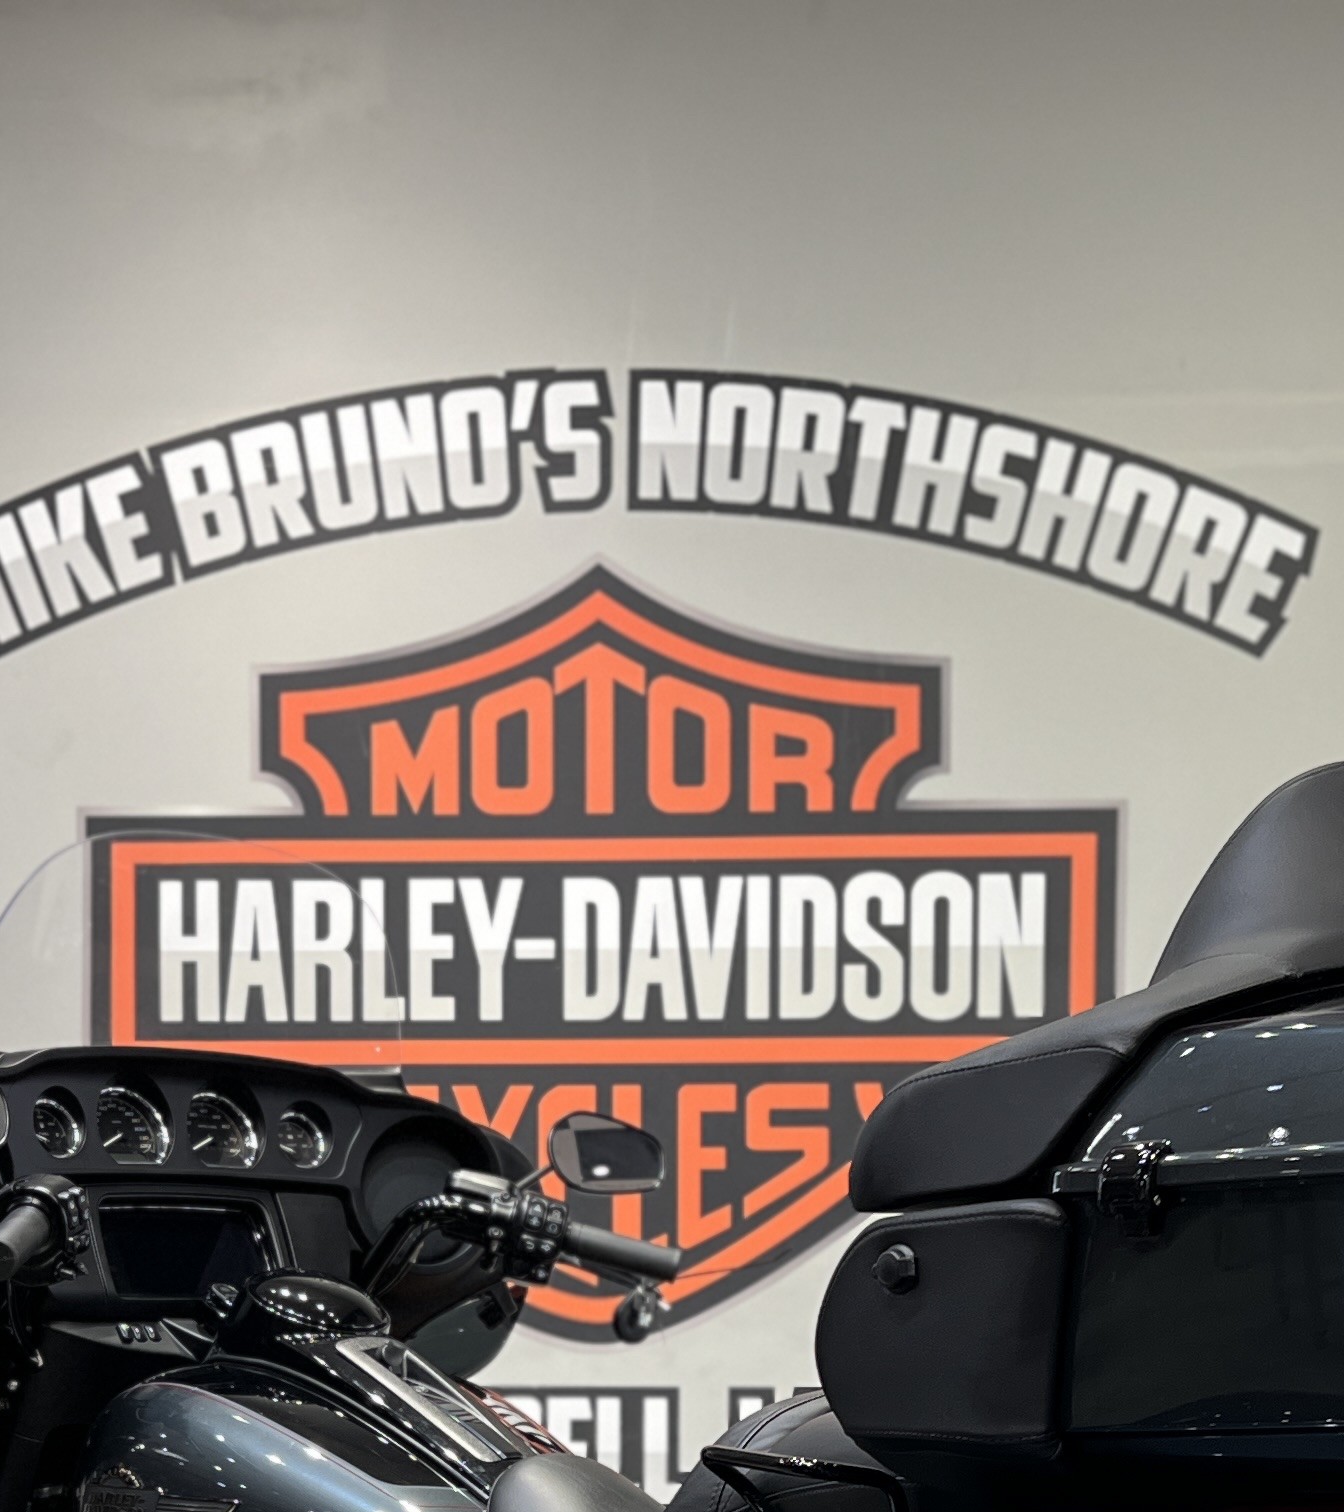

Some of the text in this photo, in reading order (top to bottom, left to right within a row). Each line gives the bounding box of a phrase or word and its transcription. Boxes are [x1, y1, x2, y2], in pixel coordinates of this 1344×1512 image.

[159, 379, 602, 568] BRUNO'S
[636, 379, 1308, 646] NORTHSHORE
[370, 642, 835, 817] MOTOR
[157, 870, 1047, 1024] HARLEY-DAVIDSON
[405, 1083, 830, 1286] YCLES
